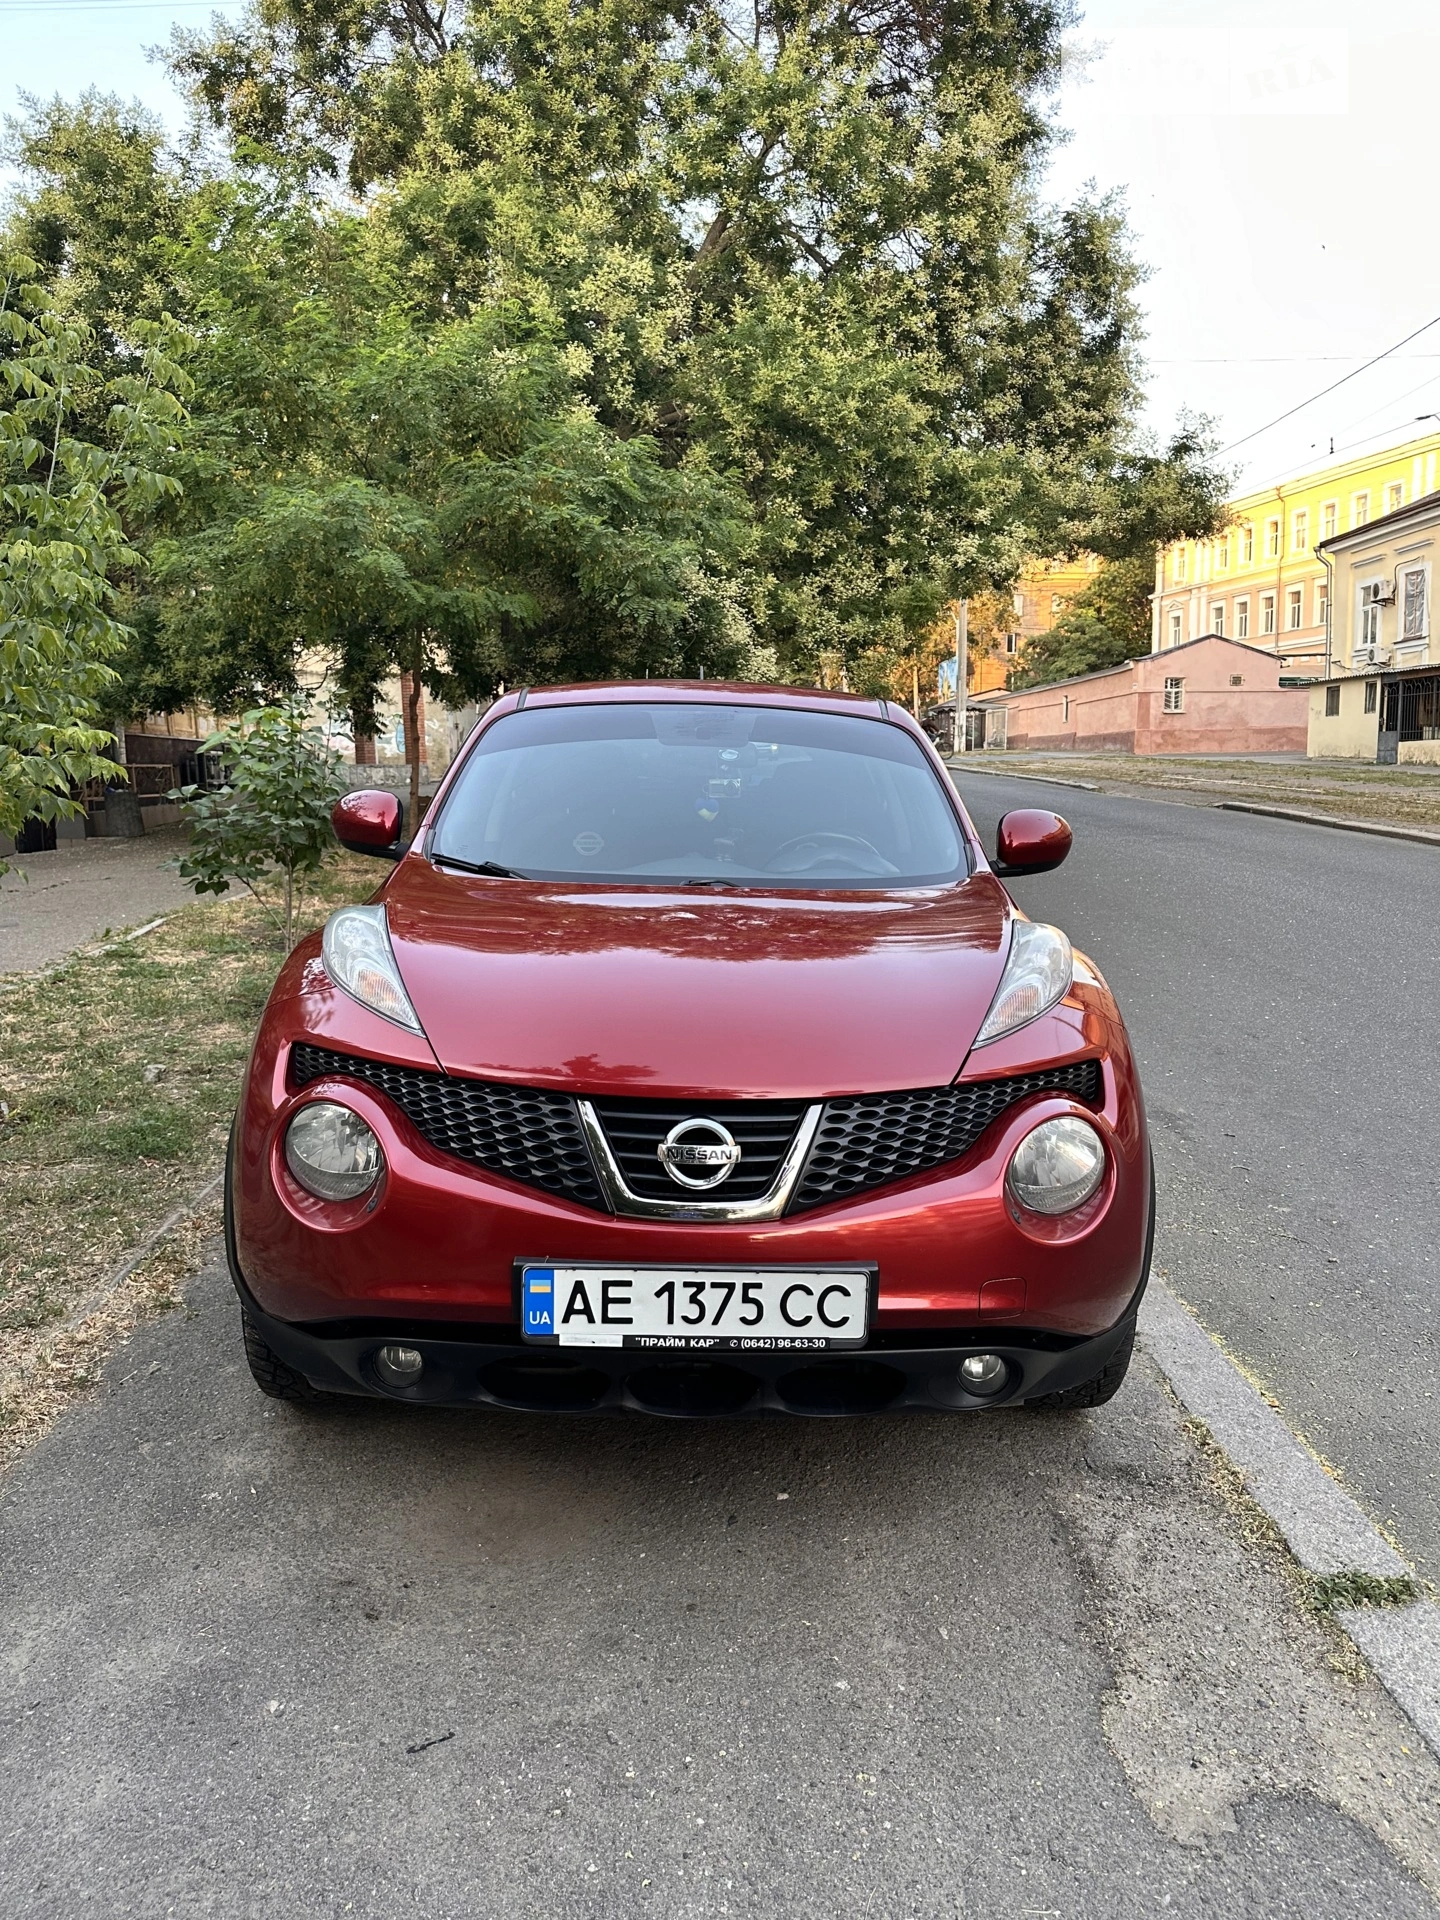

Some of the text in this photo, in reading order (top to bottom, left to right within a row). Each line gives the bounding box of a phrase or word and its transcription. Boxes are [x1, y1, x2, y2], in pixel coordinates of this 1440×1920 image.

[667, 1148, 732, 1160] NISSAN
[561, 1280, 852, 1328] AE 1375 CC
[529, 1310, 551, 1325] UA
[635, 1336, 826, 1349] "ПРАЙМ КАР" (0642) 96-63-30
